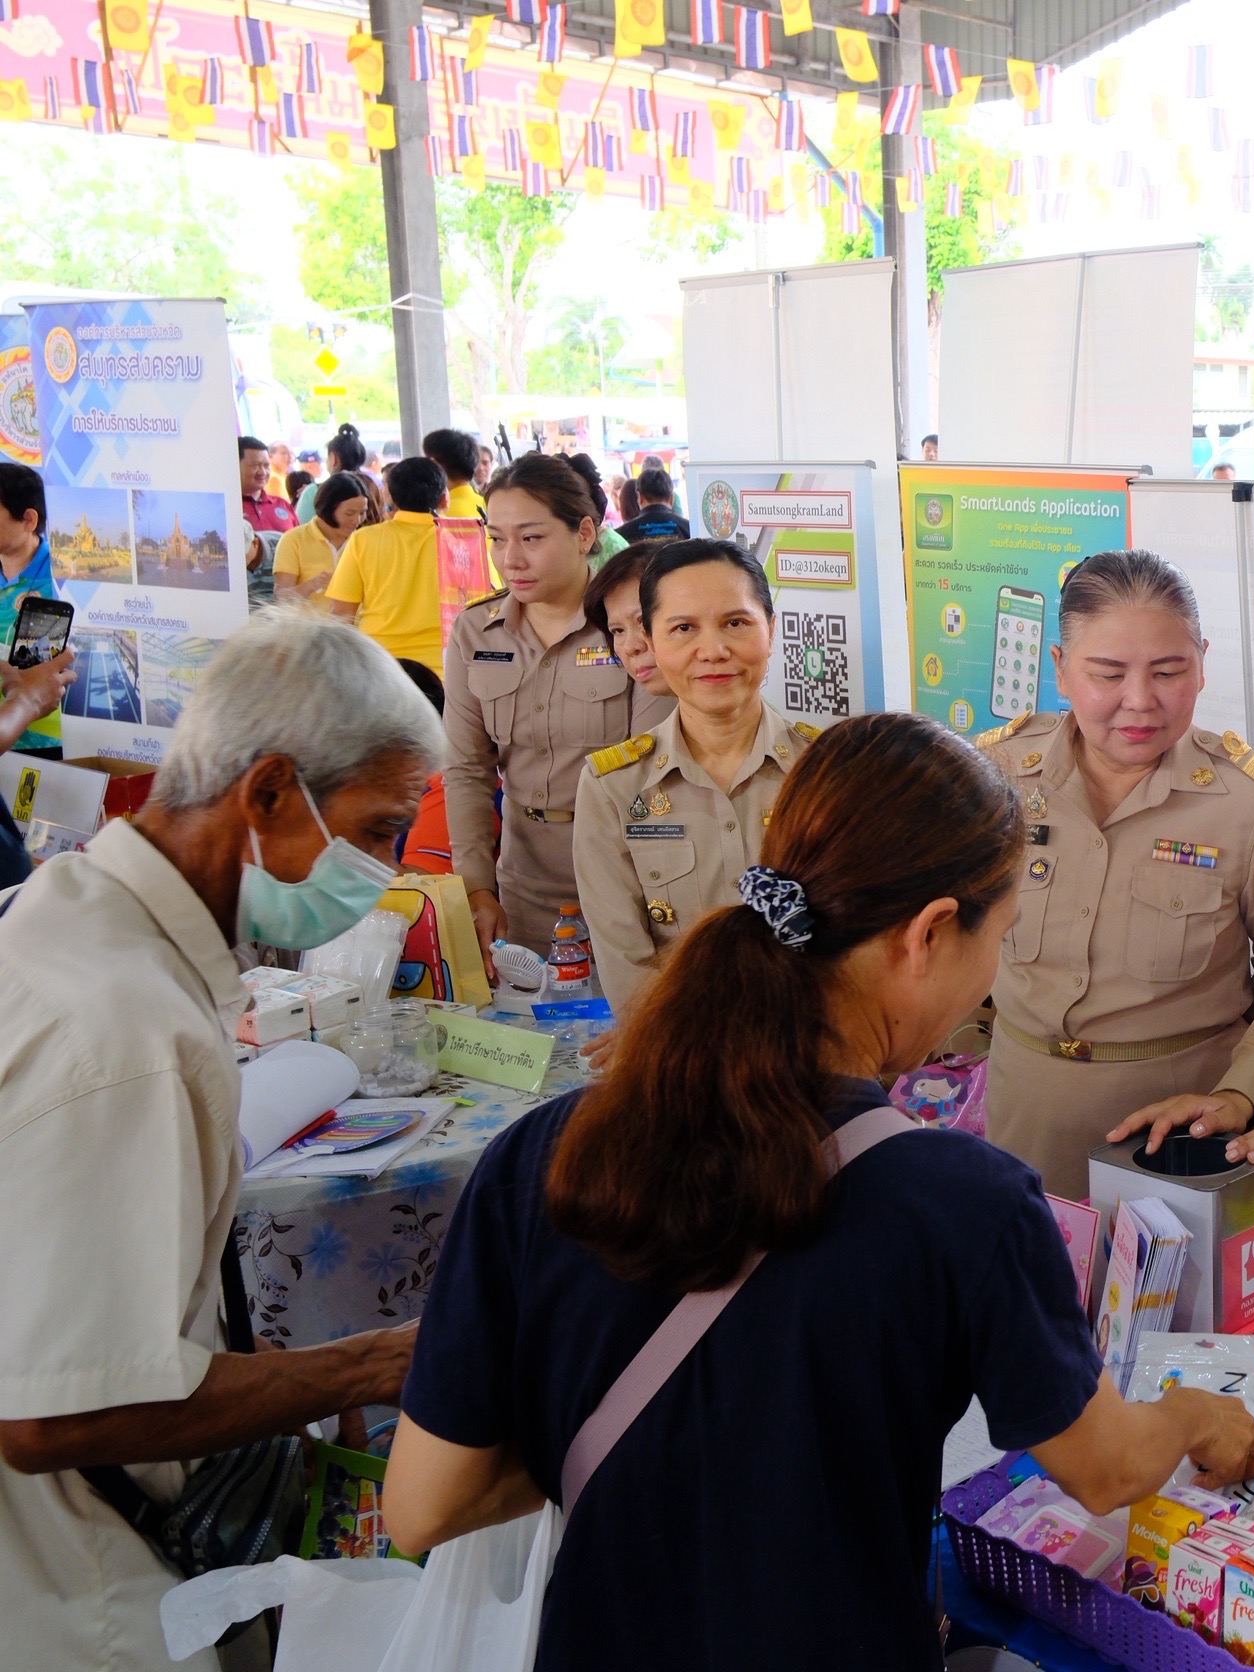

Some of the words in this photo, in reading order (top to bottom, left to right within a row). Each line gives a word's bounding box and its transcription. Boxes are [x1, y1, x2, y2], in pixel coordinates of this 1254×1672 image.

[78, 352, 202, 388] สมุทรสงคราม
[72, 409, 178, 433] การให้บริการประชาชน
[748, 502, 844, 520] SamutsongkramLand
[959, 495, 1036, 514] SmartLands
[1040, 499, 1121, 518] Application
[780, 558, 848, 578] ID:@312okeqn
[915, 559, 936, 570] สะดวก
[938, 578, 949, 591] 15
[951, 583, 972, 593] บริการ
[449, 1034, 536, 1070] ให้คำปรึกษาปัญหาที่ดิน
[1131, 1522, 1169, 1547] Malee
[1174, 1568, 1215, 1600] fresh
